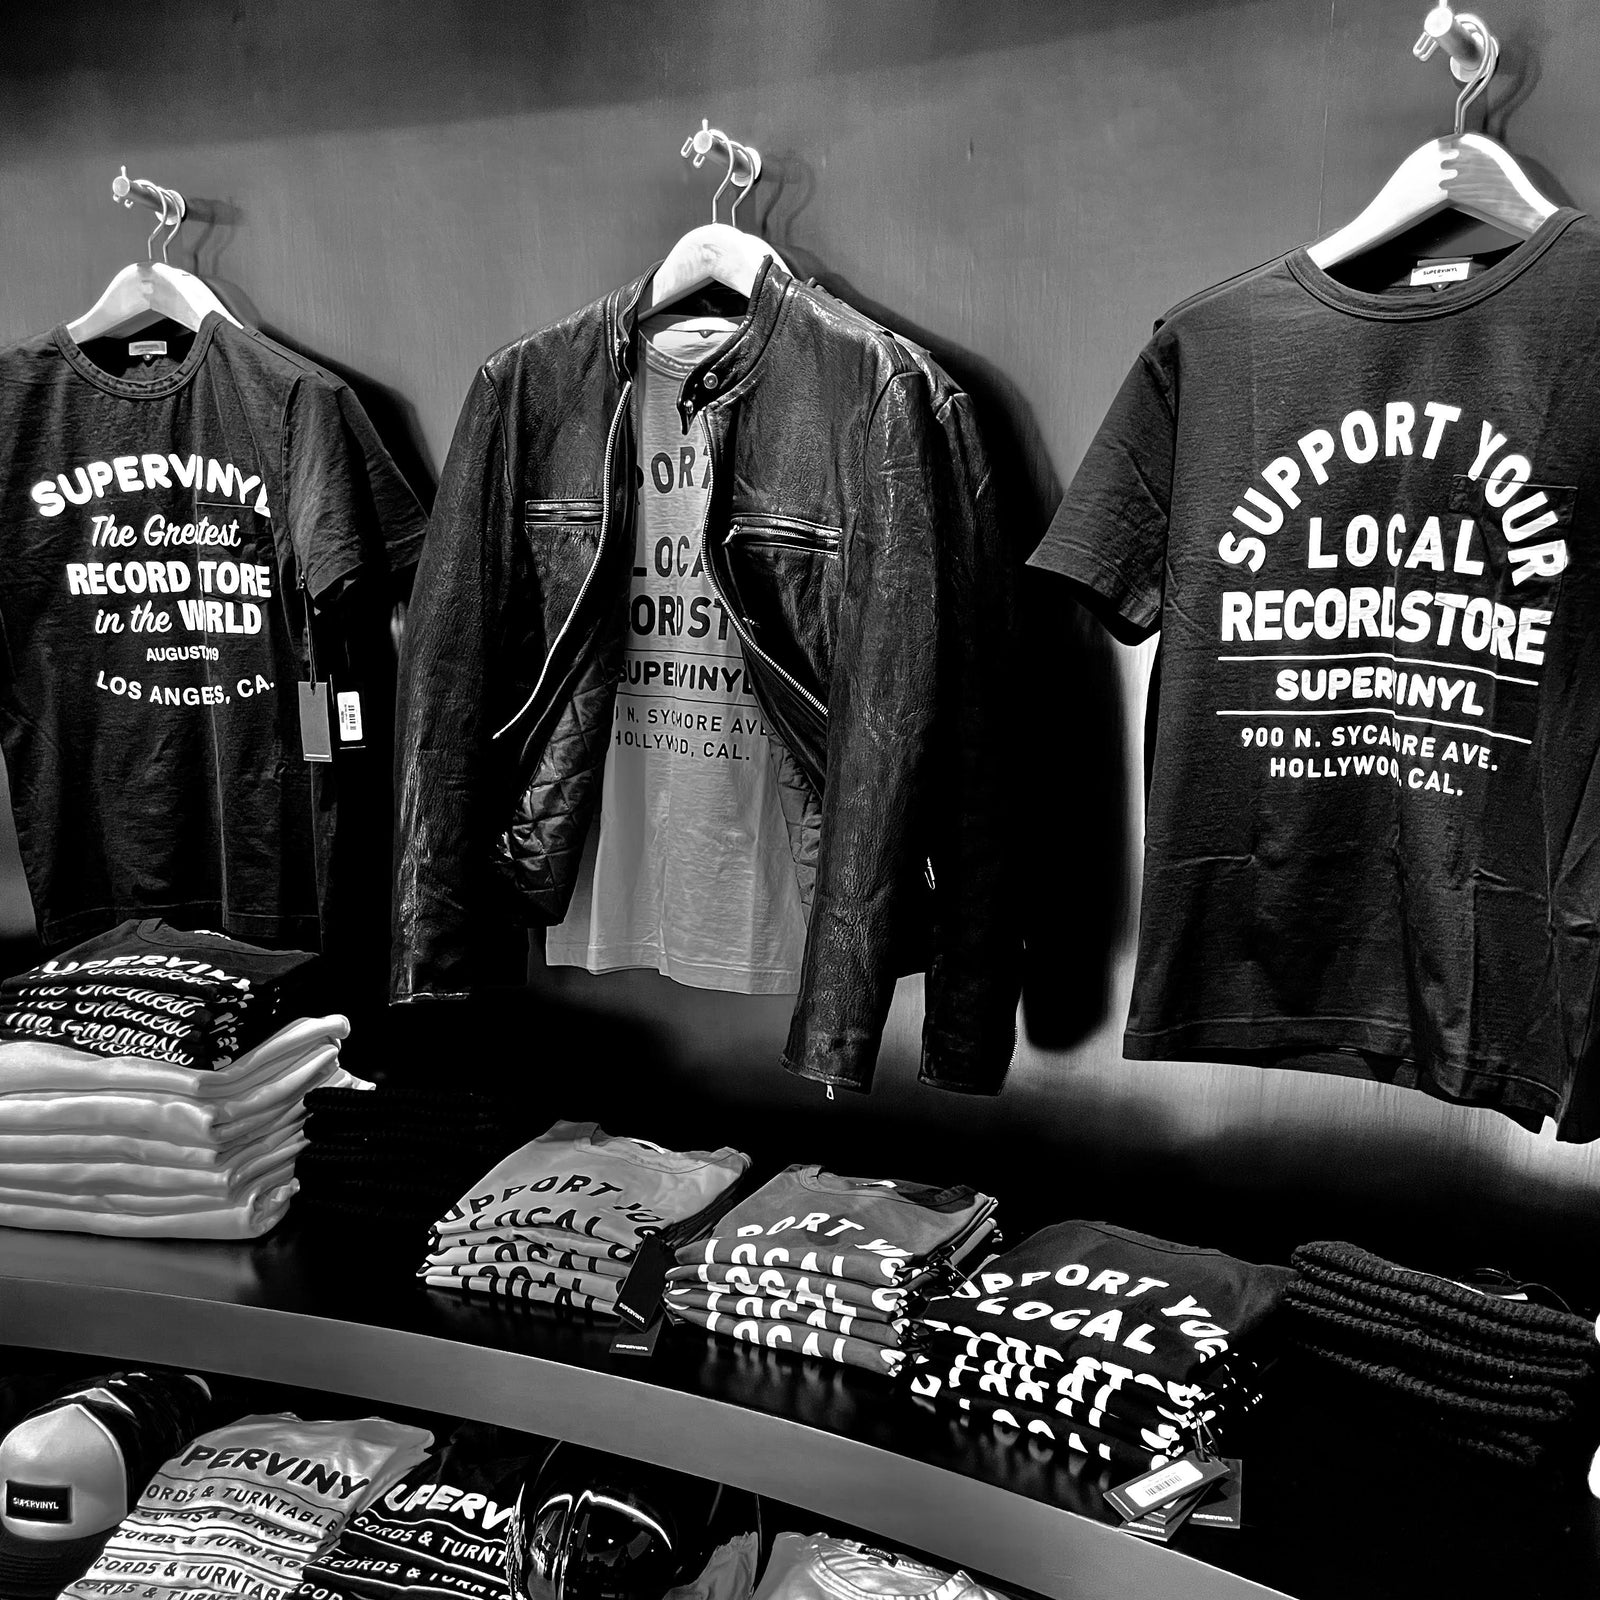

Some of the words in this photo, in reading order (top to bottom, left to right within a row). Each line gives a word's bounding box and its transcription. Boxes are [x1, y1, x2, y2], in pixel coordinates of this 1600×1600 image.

[1218, 402, 1462, 573] SUPPORT
[1468, 420, 1568, 586] YOUR
[91, 514, 137, 547] The
[1308, 513, 1485, 576] LOCAL
[66, 561, 191, 595] RECORD
[95, 609, 124, 634] in
[130, 600, 172, 633] the
[177, 600, 262, 634] WRLD
[97, 670, 142, 700] LOS
[236, 674, 275, 698] CA.
[1275, 666, 1485, 717] SUPERINYL
[703, 741, 750, 761] CAL.
[1241, 727, 1284, 748] 900
[1294, 727, 1321, 748] N.
[1442, 742, 1498, 772] AVE.
[1408, 768, 1464, 797] CAL.
[976, 1297, 1155, 1354] LOCAL
[181, 1444, 370, 1499] PERVINY
[13, 1497, 59, 1509] SUPERVINYL
[201, 1486, 215, 1498] &
[418, 1530, 433, 1547] &
[93, 1556, 160, 1574] CORDS
[163, 1561, 178, 1577] &
[406, 1567, 421, 1580] &
[142, 1587, 158, 1599] &
